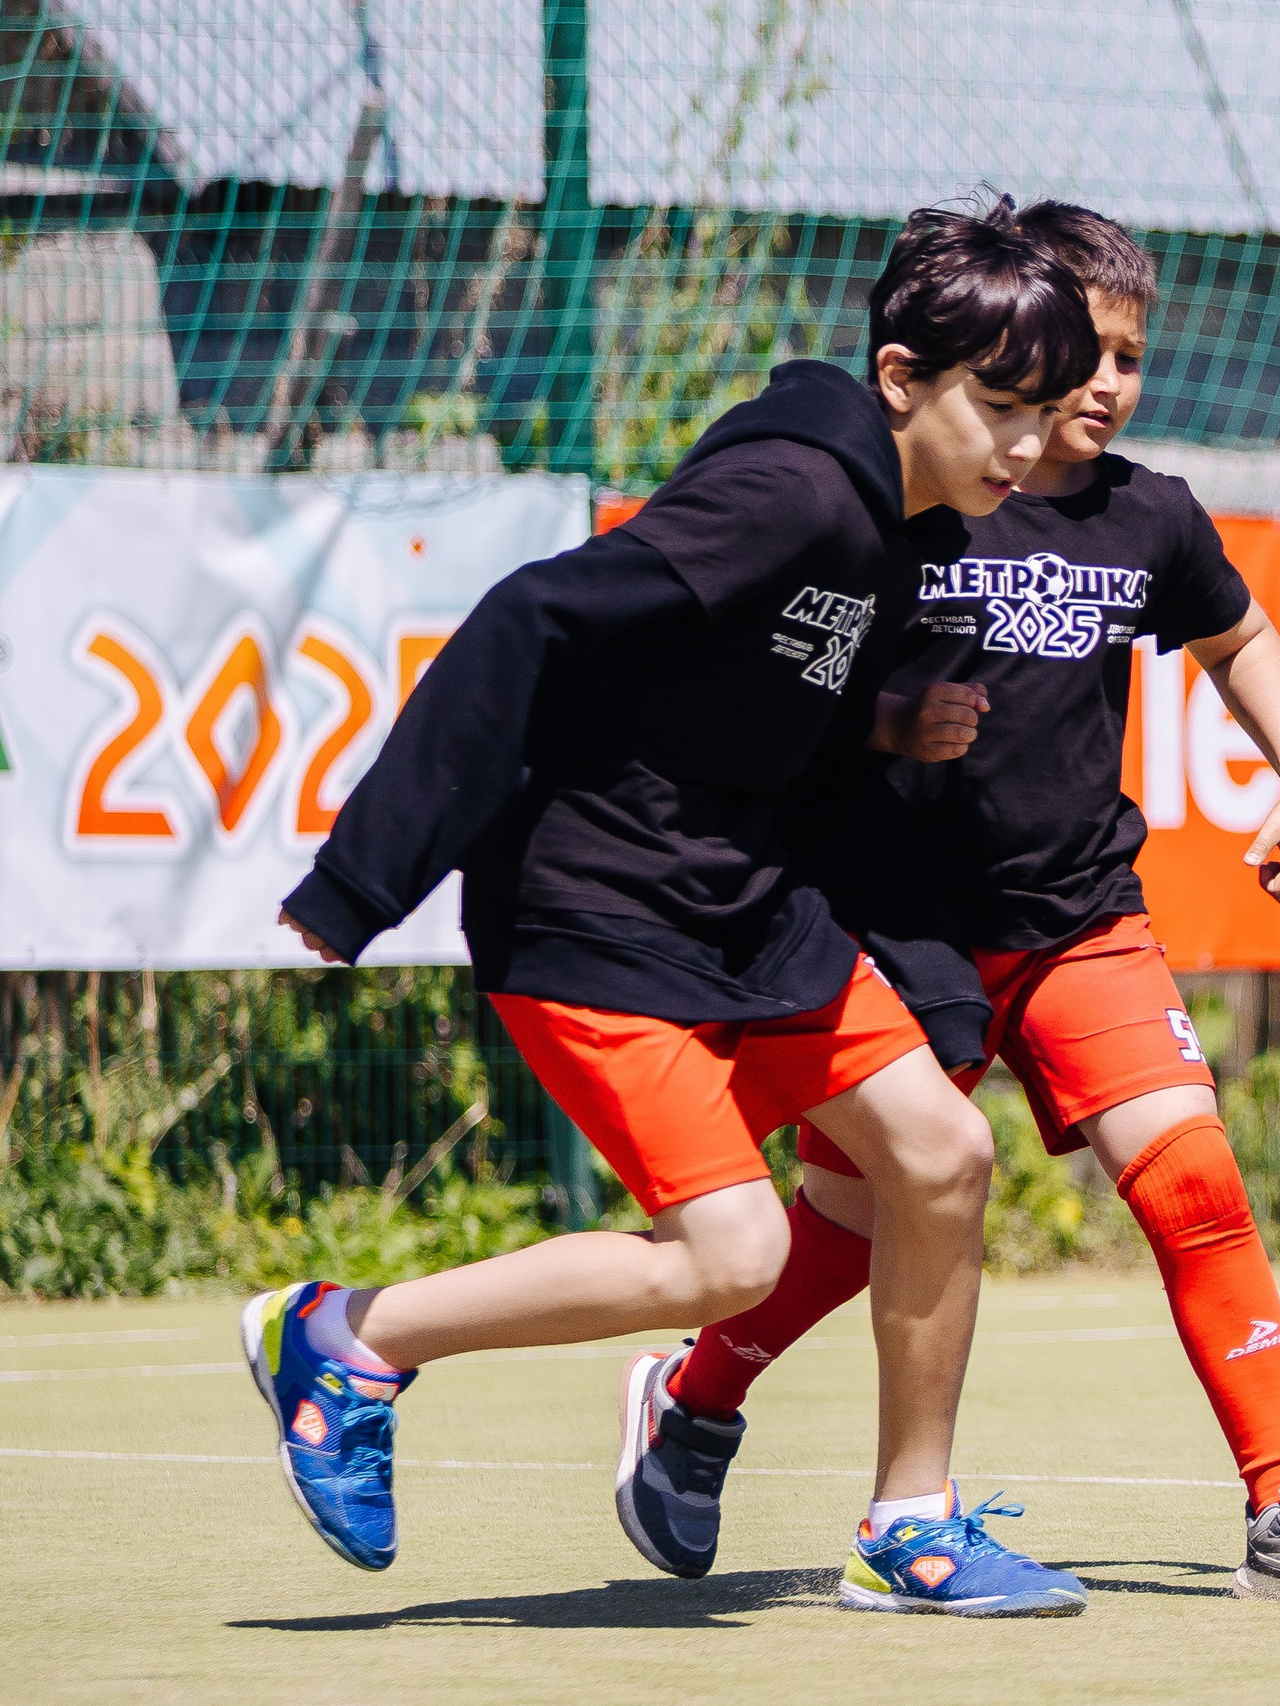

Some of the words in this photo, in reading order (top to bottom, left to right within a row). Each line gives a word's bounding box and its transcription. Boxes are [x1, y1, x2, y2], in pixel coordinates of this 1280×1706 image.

[920, 615, 977, 624] ФЕСТИВАЛЬ
[931, 625, 977, 635] ДЕТСКОГО
[983, 599, 1103, 658] 2025
[1165, 1008, 1207, 1065] 5
